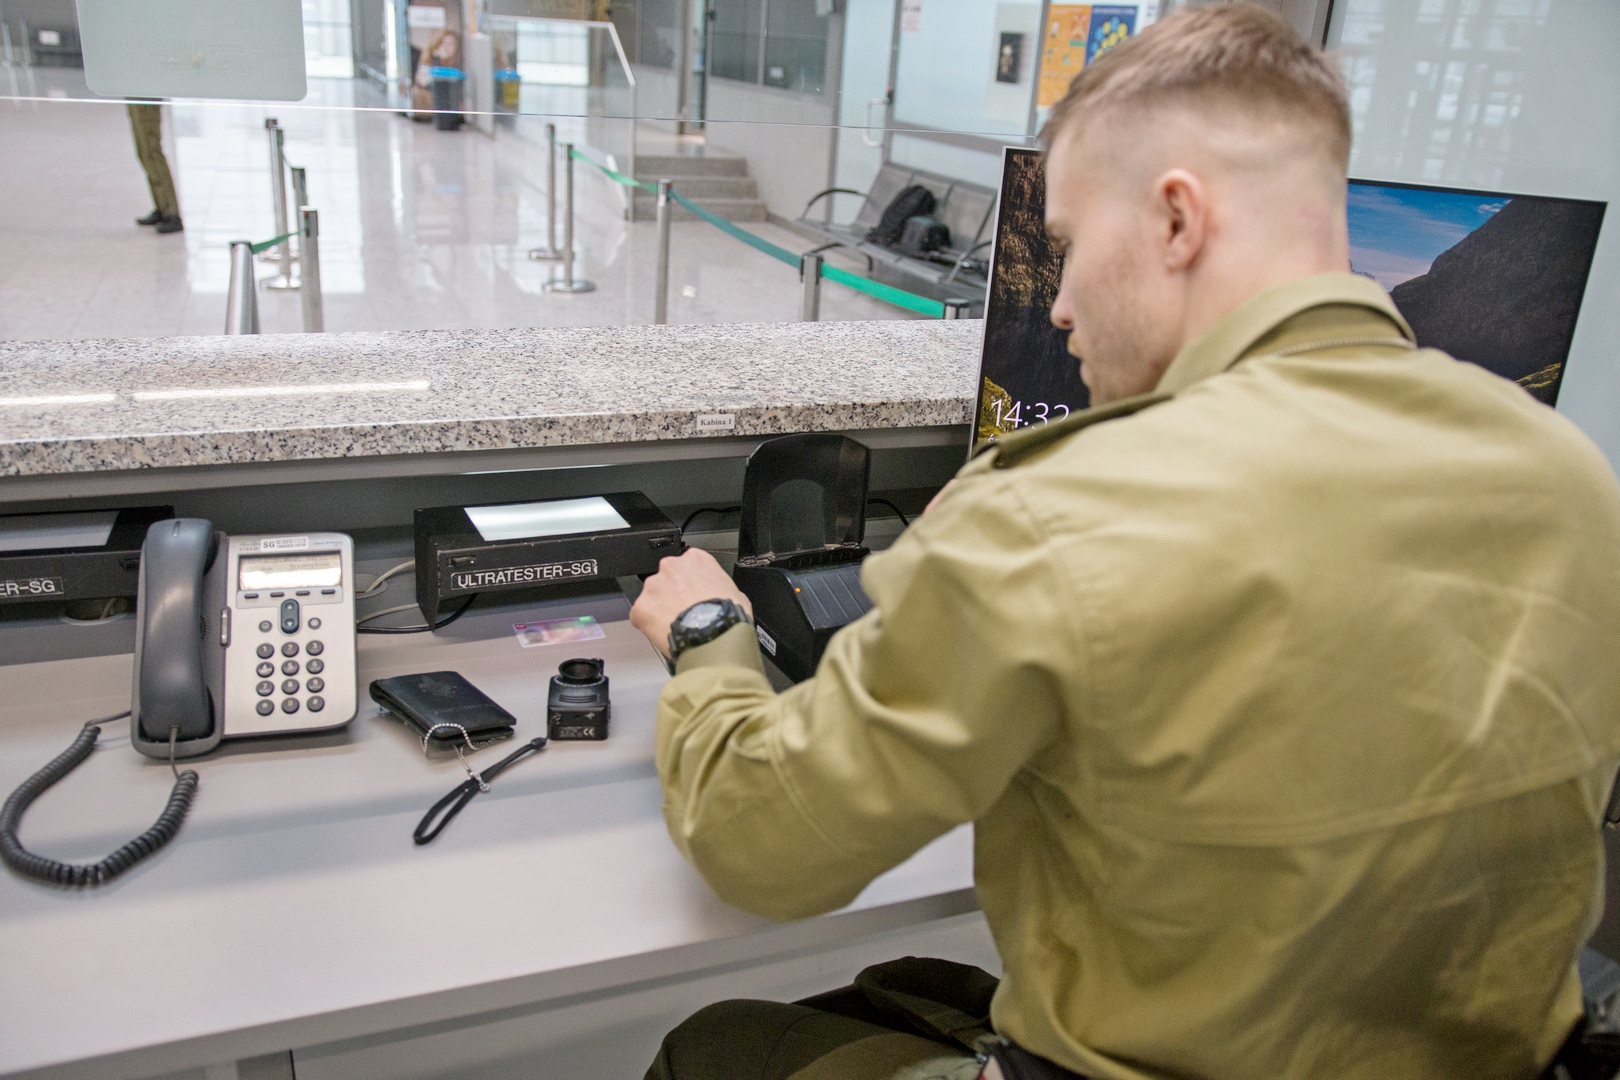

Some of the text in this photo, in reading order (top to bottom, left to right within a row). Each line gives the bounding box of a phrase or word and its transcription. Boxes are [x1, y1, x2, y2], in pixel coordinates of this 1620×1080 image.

[700, 418, 726, 426] Kabina
[263, 541, 275, 549] SG
[457, 562, 591, 588] ULTRATESTER-SG
